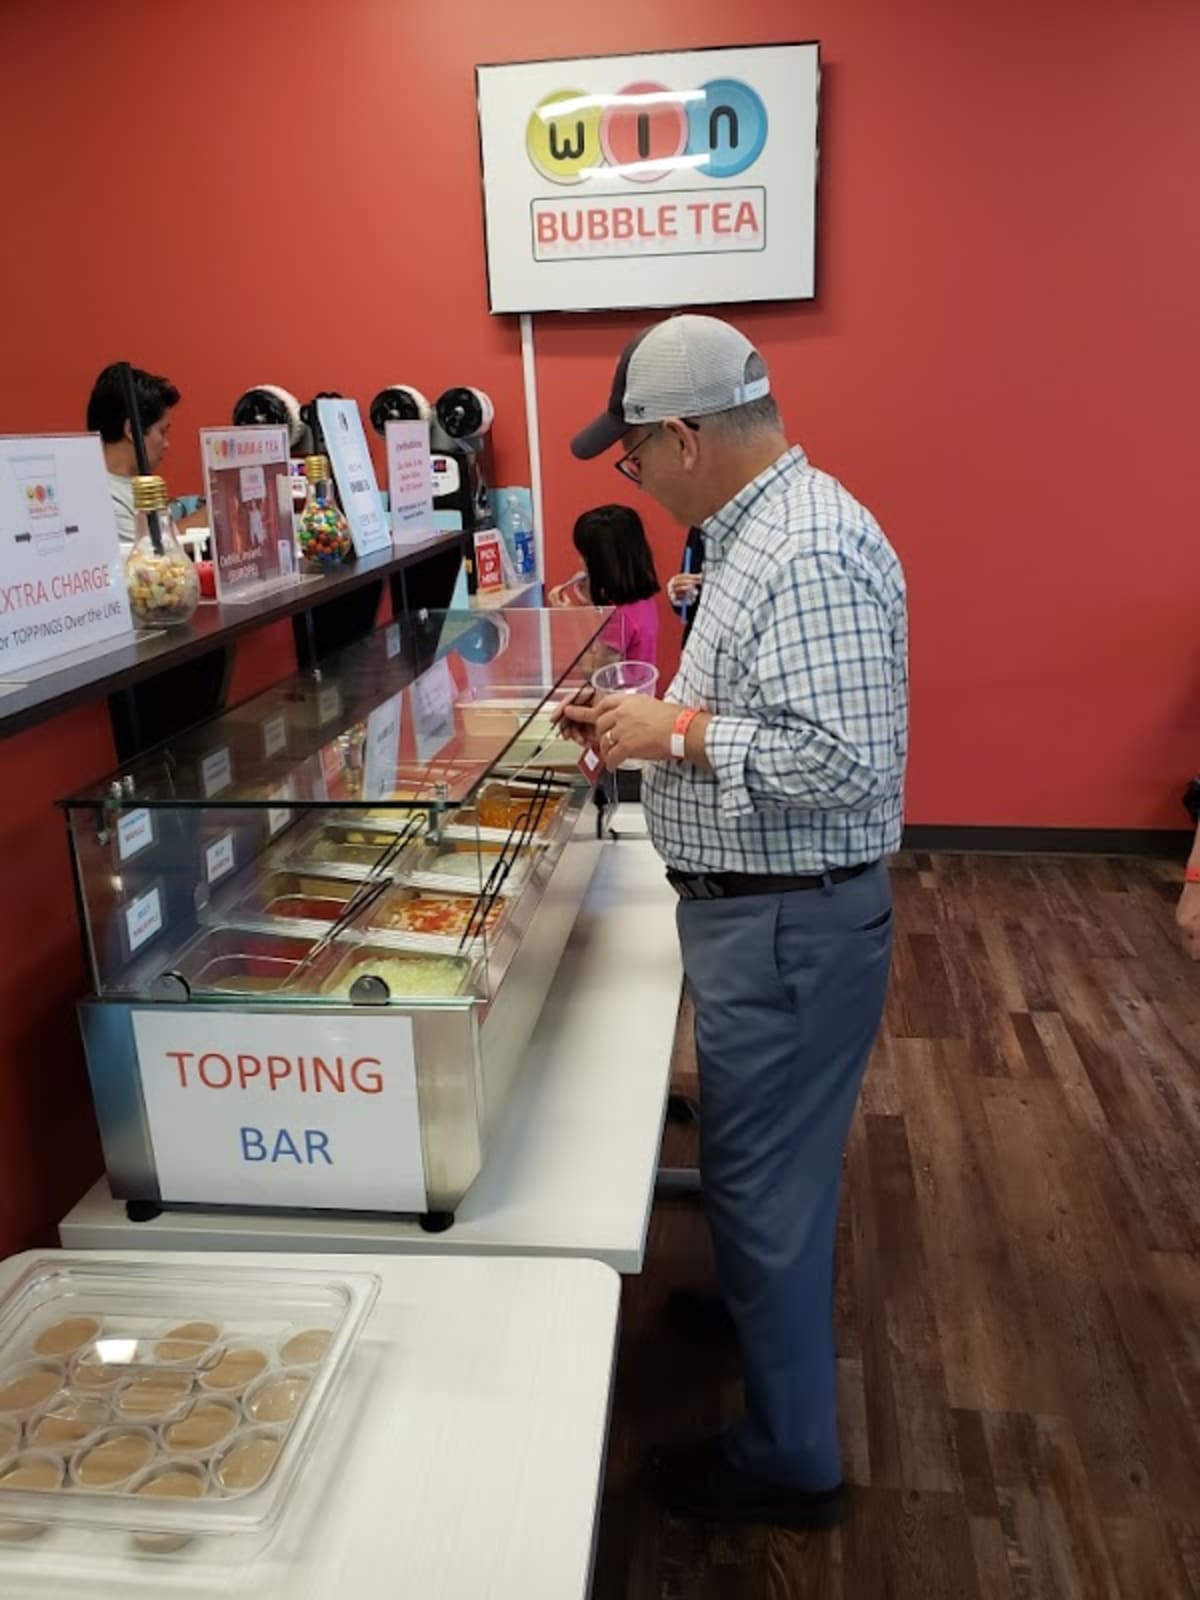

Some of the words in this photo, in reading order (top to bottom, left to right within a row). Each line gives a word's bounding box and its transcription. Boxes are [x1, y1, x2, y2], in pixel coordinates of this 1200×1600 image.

[537, 204, 678, 243] BUBBLE
[686, 200, 760, 235] TEA
[0, 579, 49, 615] XTRA
[51, 565, 110, 600] CHARGE
[11, 614, 64, 647] TOPPINGS
[65, 612, 87, 631] Over
[87, 606, 103, 622] the
[103, 600, 122, 620] LINE
[166, 1051, 384, 1094] TOPPING
[239, 1127, 334, 1165] BAR
